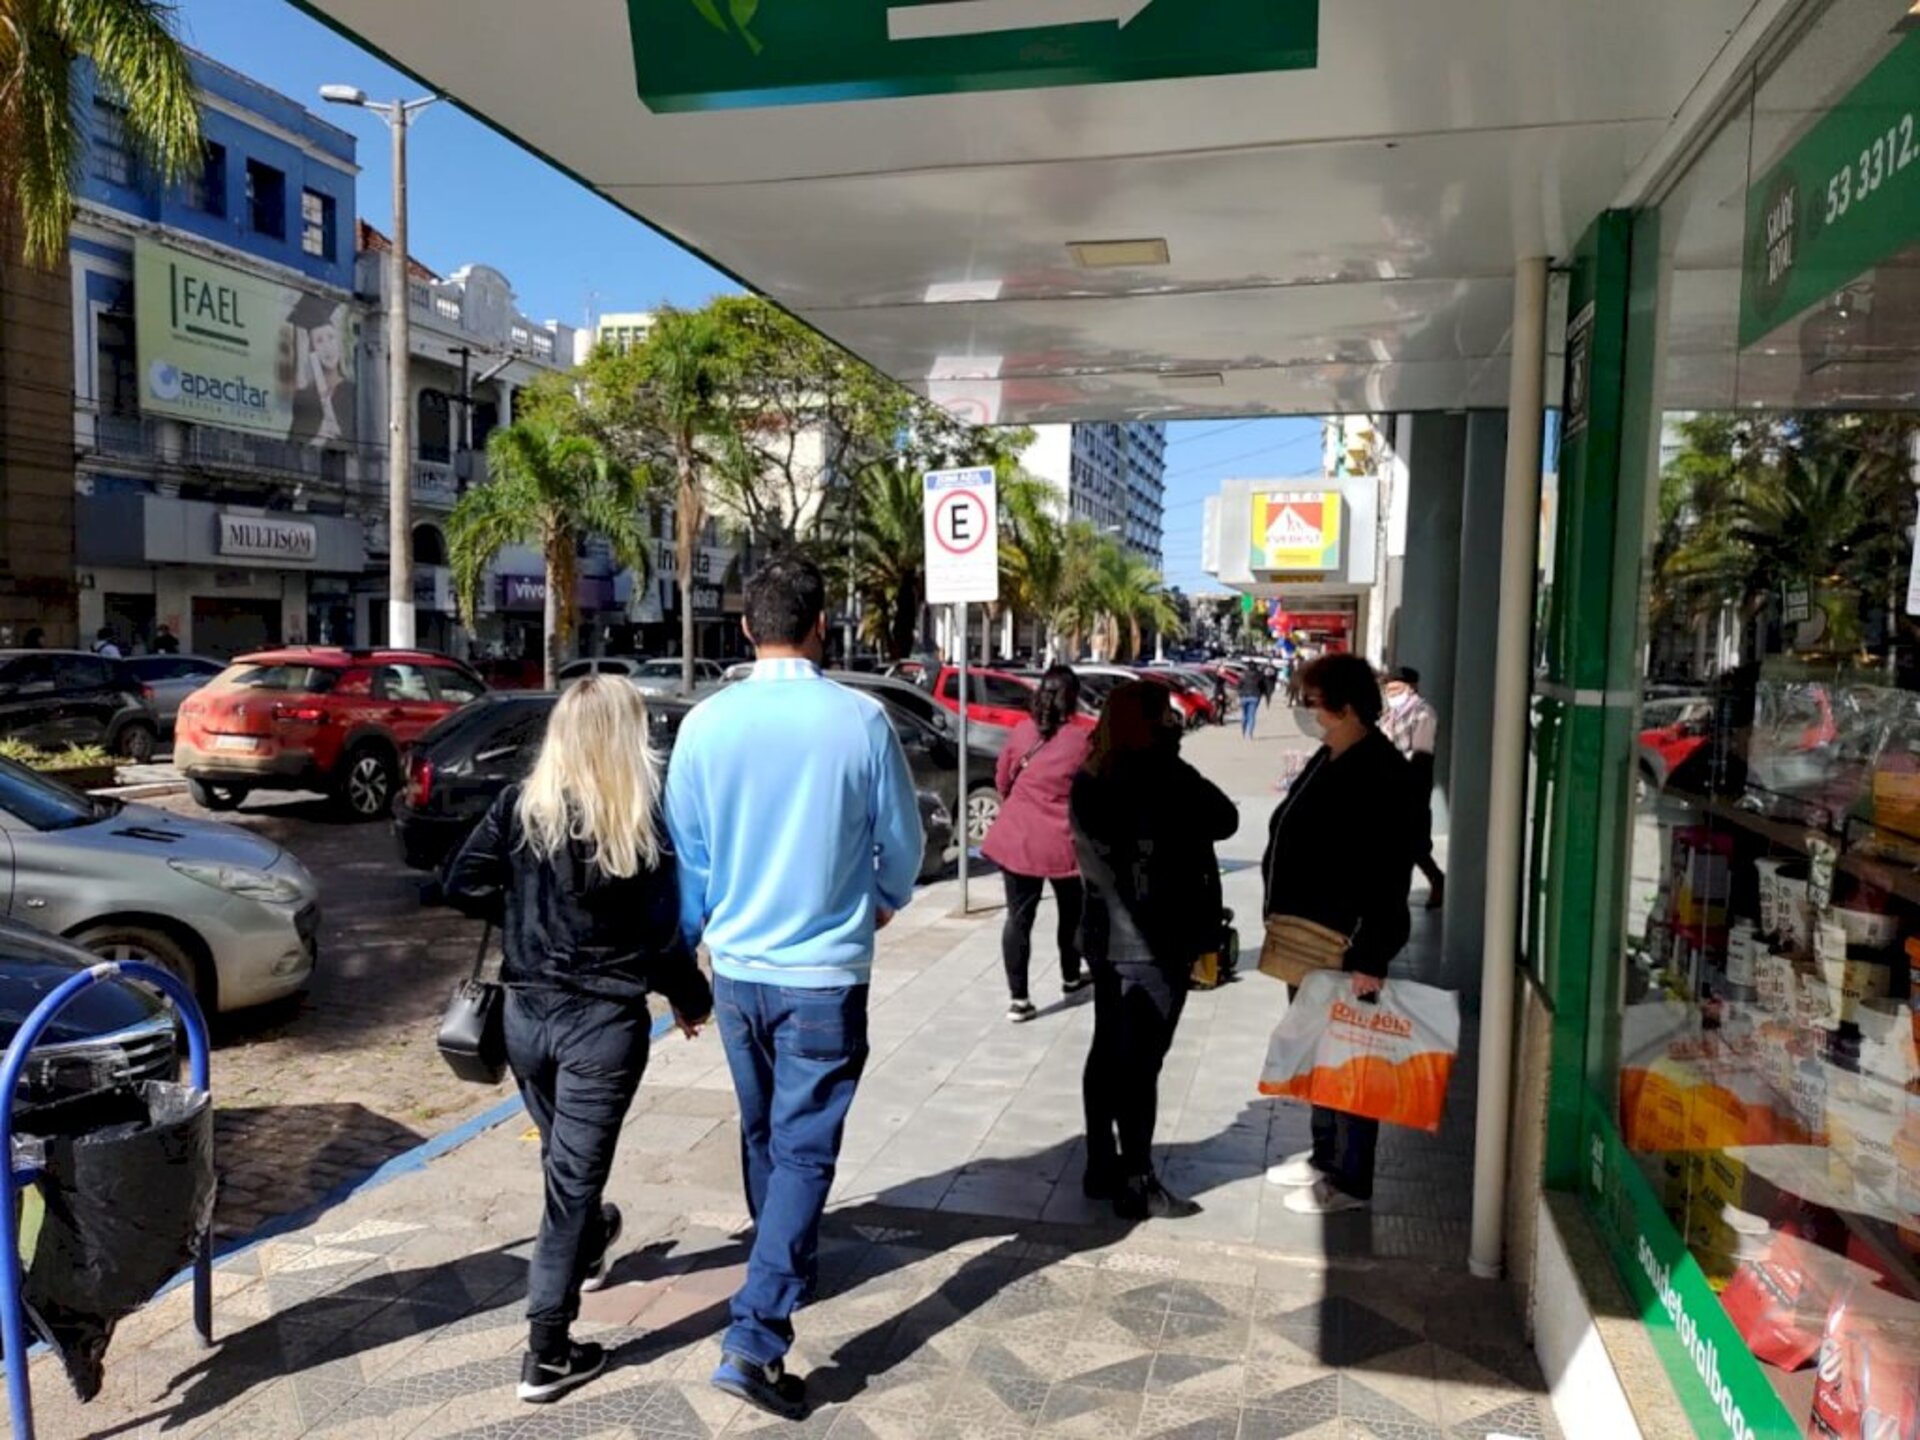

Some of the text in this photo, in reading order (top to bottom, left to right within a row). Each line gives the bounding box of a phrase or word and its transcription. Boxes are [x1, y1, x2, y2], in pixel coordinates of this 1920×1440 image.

[1825, 164, 1851, 225] 53
[183, 276, 246, 329] FAEL
[229, 524, 312, 553] MULTISOM
[951, 504, 970, 540] E
[514, 578, 546, 600] vivo
